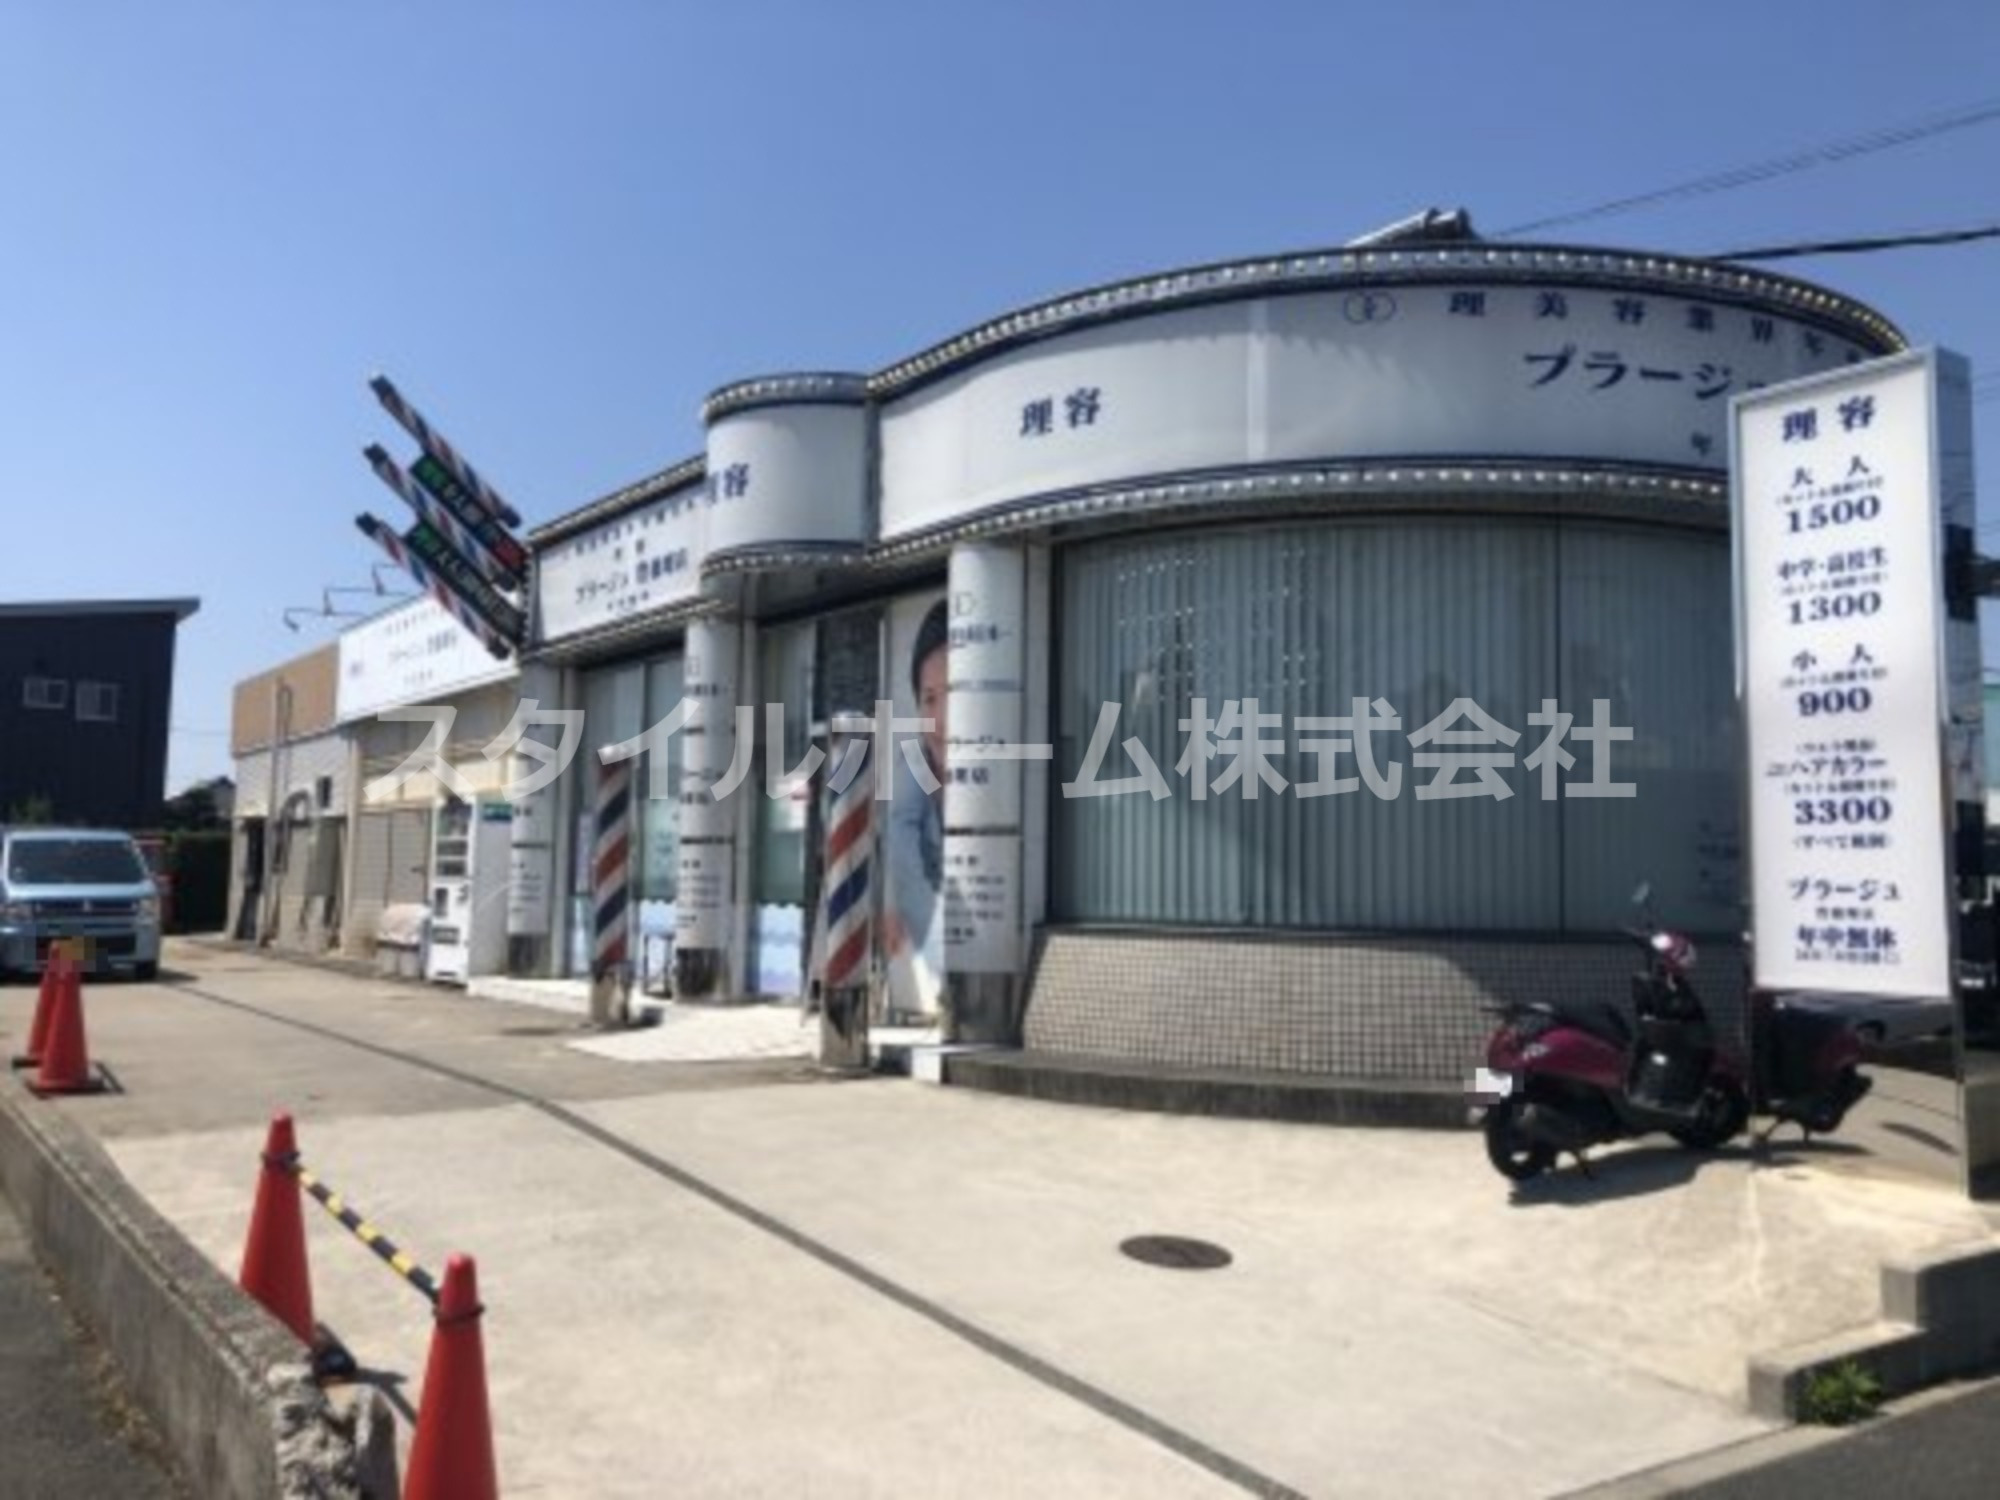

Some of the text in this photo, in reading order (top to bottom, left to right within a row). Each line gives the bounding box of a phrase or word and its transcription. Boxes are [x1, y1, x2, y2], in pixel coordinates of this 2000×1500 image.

[1019, 387, 1100, 437] 理容
[1781, 394, 1877, 443] 理容
[1786, 495, 1881, 534] 1500
[1788, 592, 1882, 625] 1300
[1798, 687, 1872, 717] 900
[1794, 796, 1892, 825] 3300
[1790, 876, 1902, 901] プラージュ
